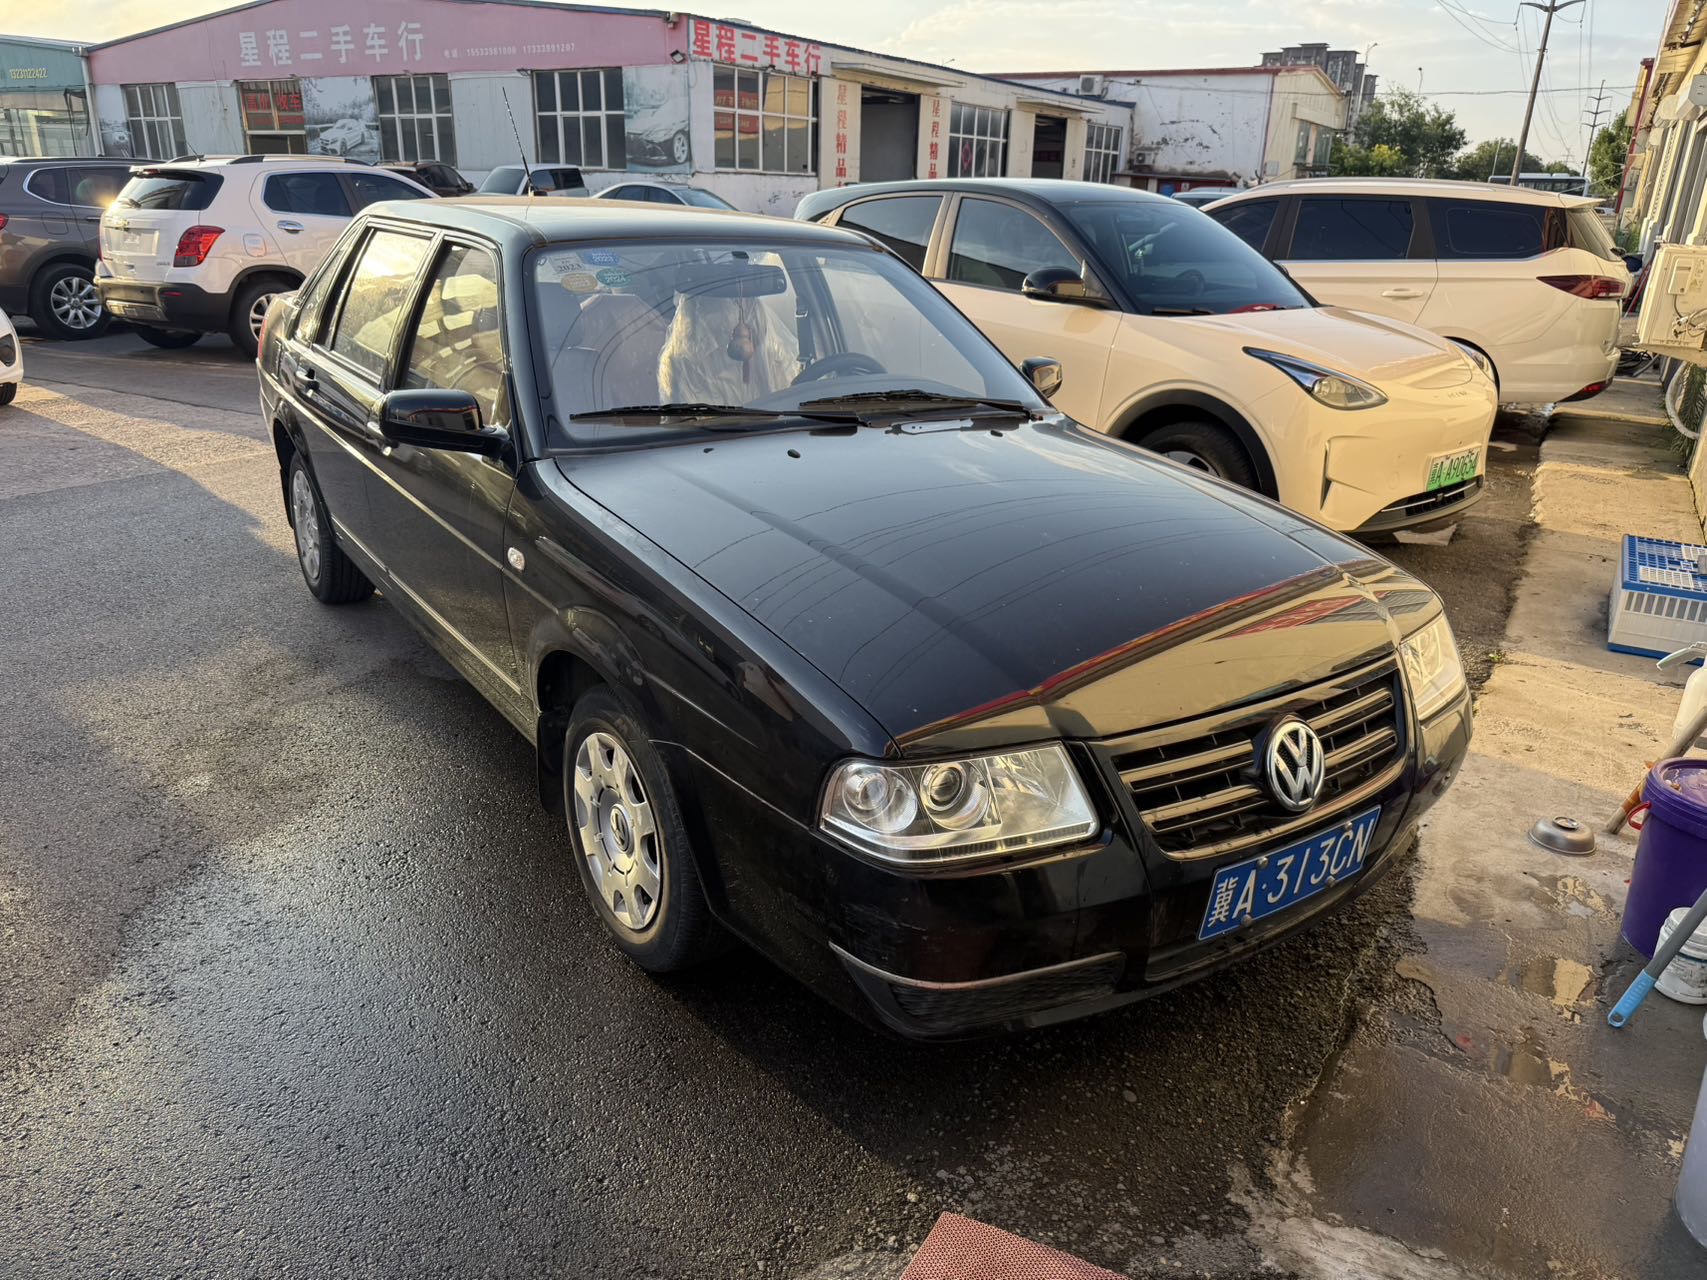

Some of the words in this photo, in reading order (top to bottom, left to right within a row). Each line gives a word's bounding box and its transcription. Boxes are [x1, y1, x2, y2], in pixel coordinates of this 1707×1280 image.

[239, 20, 424, 67] 星程二手车行
[692, 19, 821, 76] 星程二手车行
